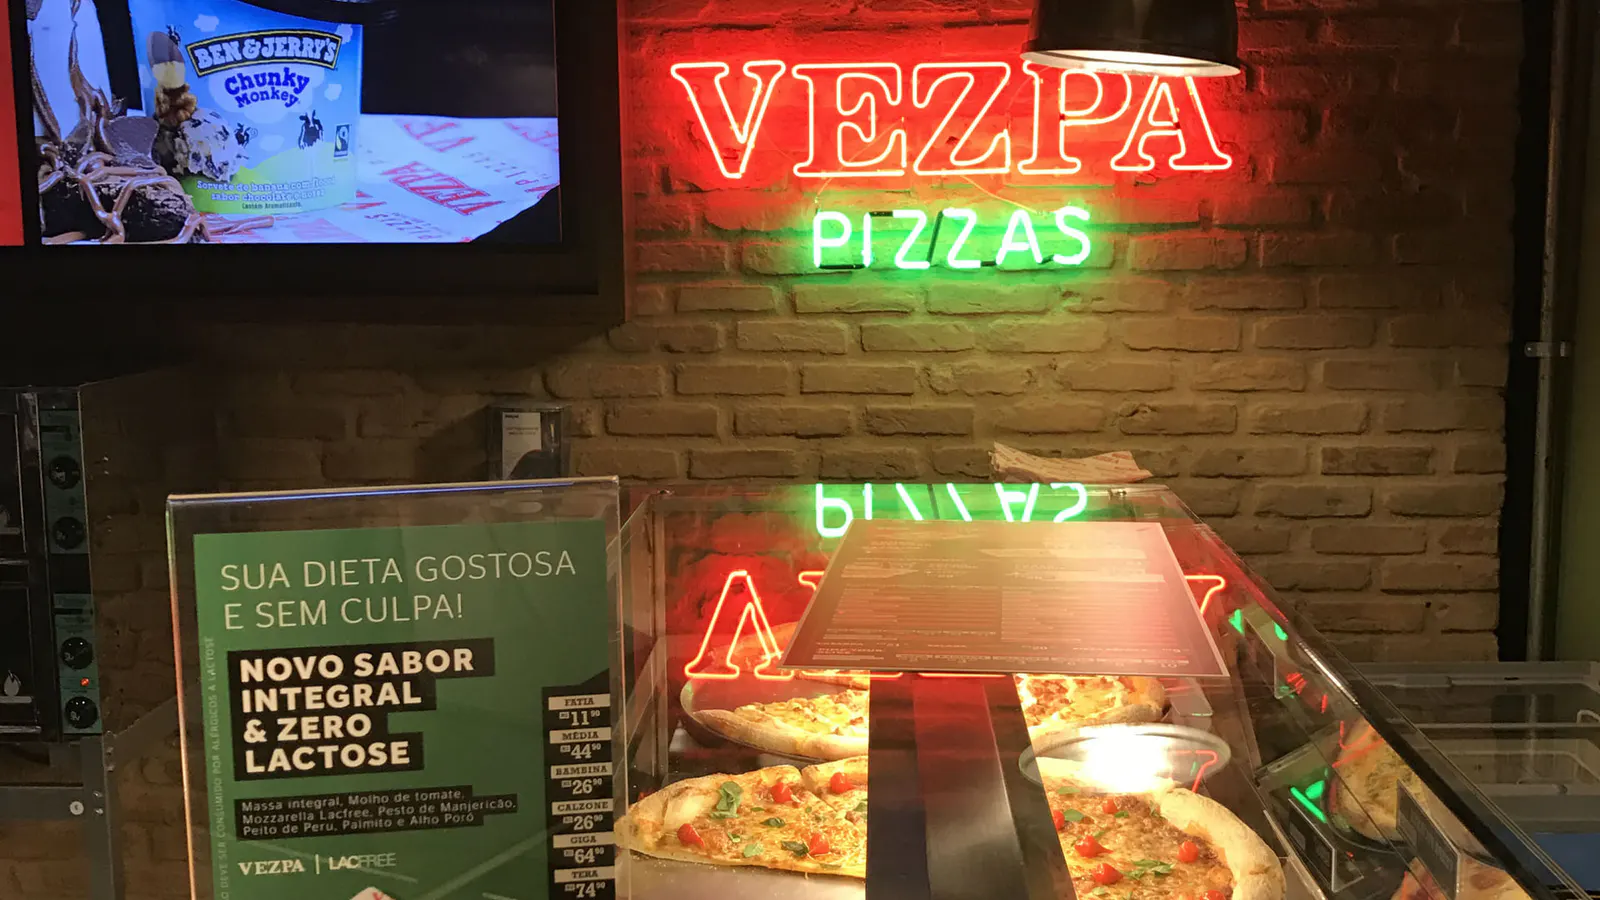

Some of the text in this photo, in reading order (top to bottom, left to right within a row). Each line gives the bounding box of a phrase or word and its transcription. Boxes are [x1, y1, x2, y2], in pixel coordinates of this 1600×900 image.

[224, 67, 310, 95] Chunky
[234, 86, 299, 108] Monkey
[670, 60, 1232, 179] VEZPA
[197, 181, 235, 191] Sorvete
[236, 181, 250, 192] de
[251, 181, 289, 192] banana
[211, 192, 240, 201] sabor
[812, 206, 1092, 269] PIZZAS
[221, 550, 576, 591] SUA DIETA GOSTOSA
[224, 593, 463, 630] E SEM CULPA!
[240, 648, 475, 683] NOVO SABOR
[242, 681, 422, 713] INTEGRAL
[564, 697, 595, 706] FATIA
[243, 713, 372, 743] & ZERO
[562, 731, 599, 740] MÉDIA
[245, 741, 410, 773] LACTOSE
[555, 765, 608, 775] BAMBINA
[242, 801, 283, 812] Massa
[348, 794, 389, 805] Molho
[394, 792, 410, 802] de
[557, 801, 609, 812] CALZONE
[243, 812, 314, 824] Mozzarella
[378, 806, 415, 817] Pesto
[419, 803, 435, 814] de
[243, 825, 278, 836] Peito
[282, 824, 299, 834] de
[342, 819, 393, 830] Palmito
[397, 818, 405, 827] e
[410, 815, 440, 825] Alho
[570, 835, 597, 844] GIGA
[238, 852, 397, 875] VEZPA LACFREE
[218, 864, 229, 888] DEVE
